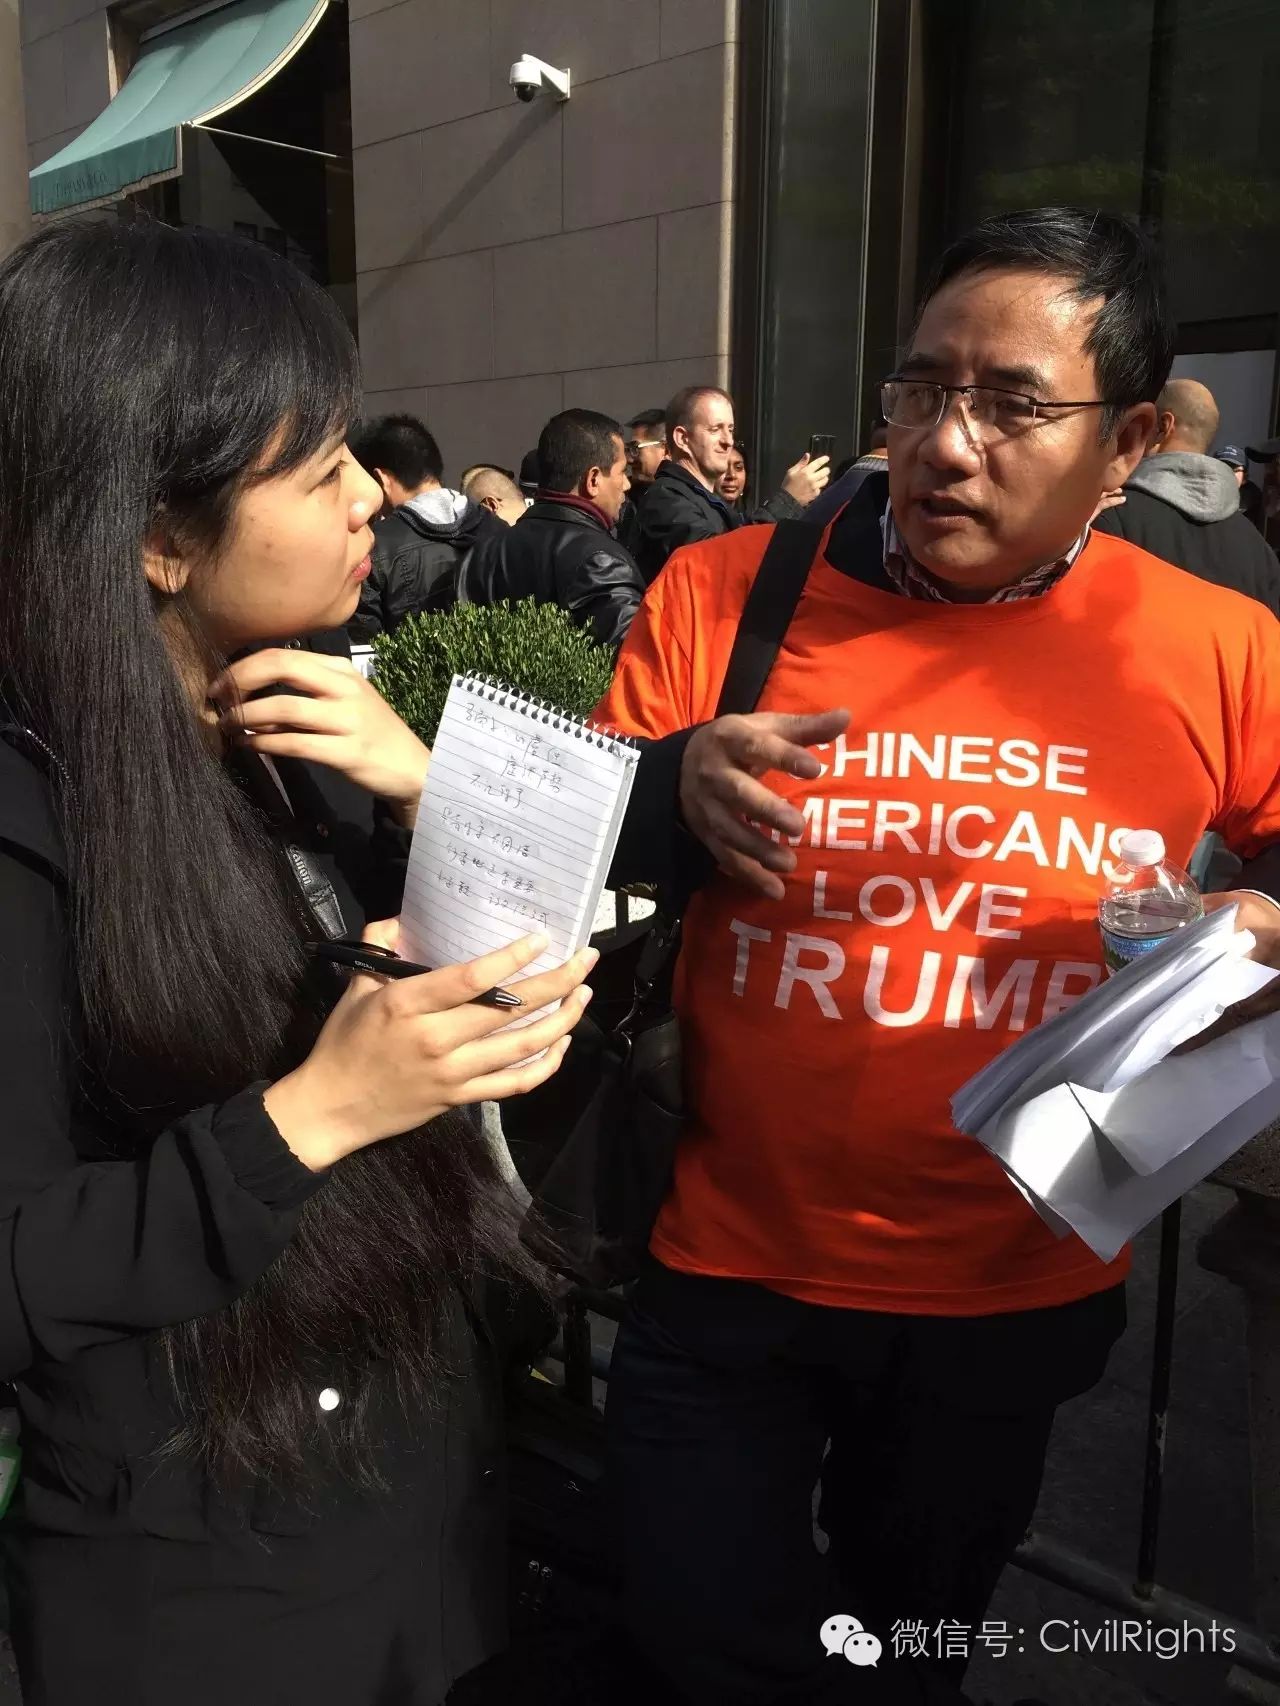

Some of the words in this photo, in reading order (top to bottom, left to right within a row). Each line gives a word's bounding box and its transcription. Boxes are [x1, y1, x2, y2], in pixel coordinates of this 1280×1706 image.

[788, 732, 1088, 795] HINESE
[752, 797, 1136, 884] MERICANS
[812, 870, 1028, 940] LOVE
[729, 918, 1102, 1032] TRUMP
